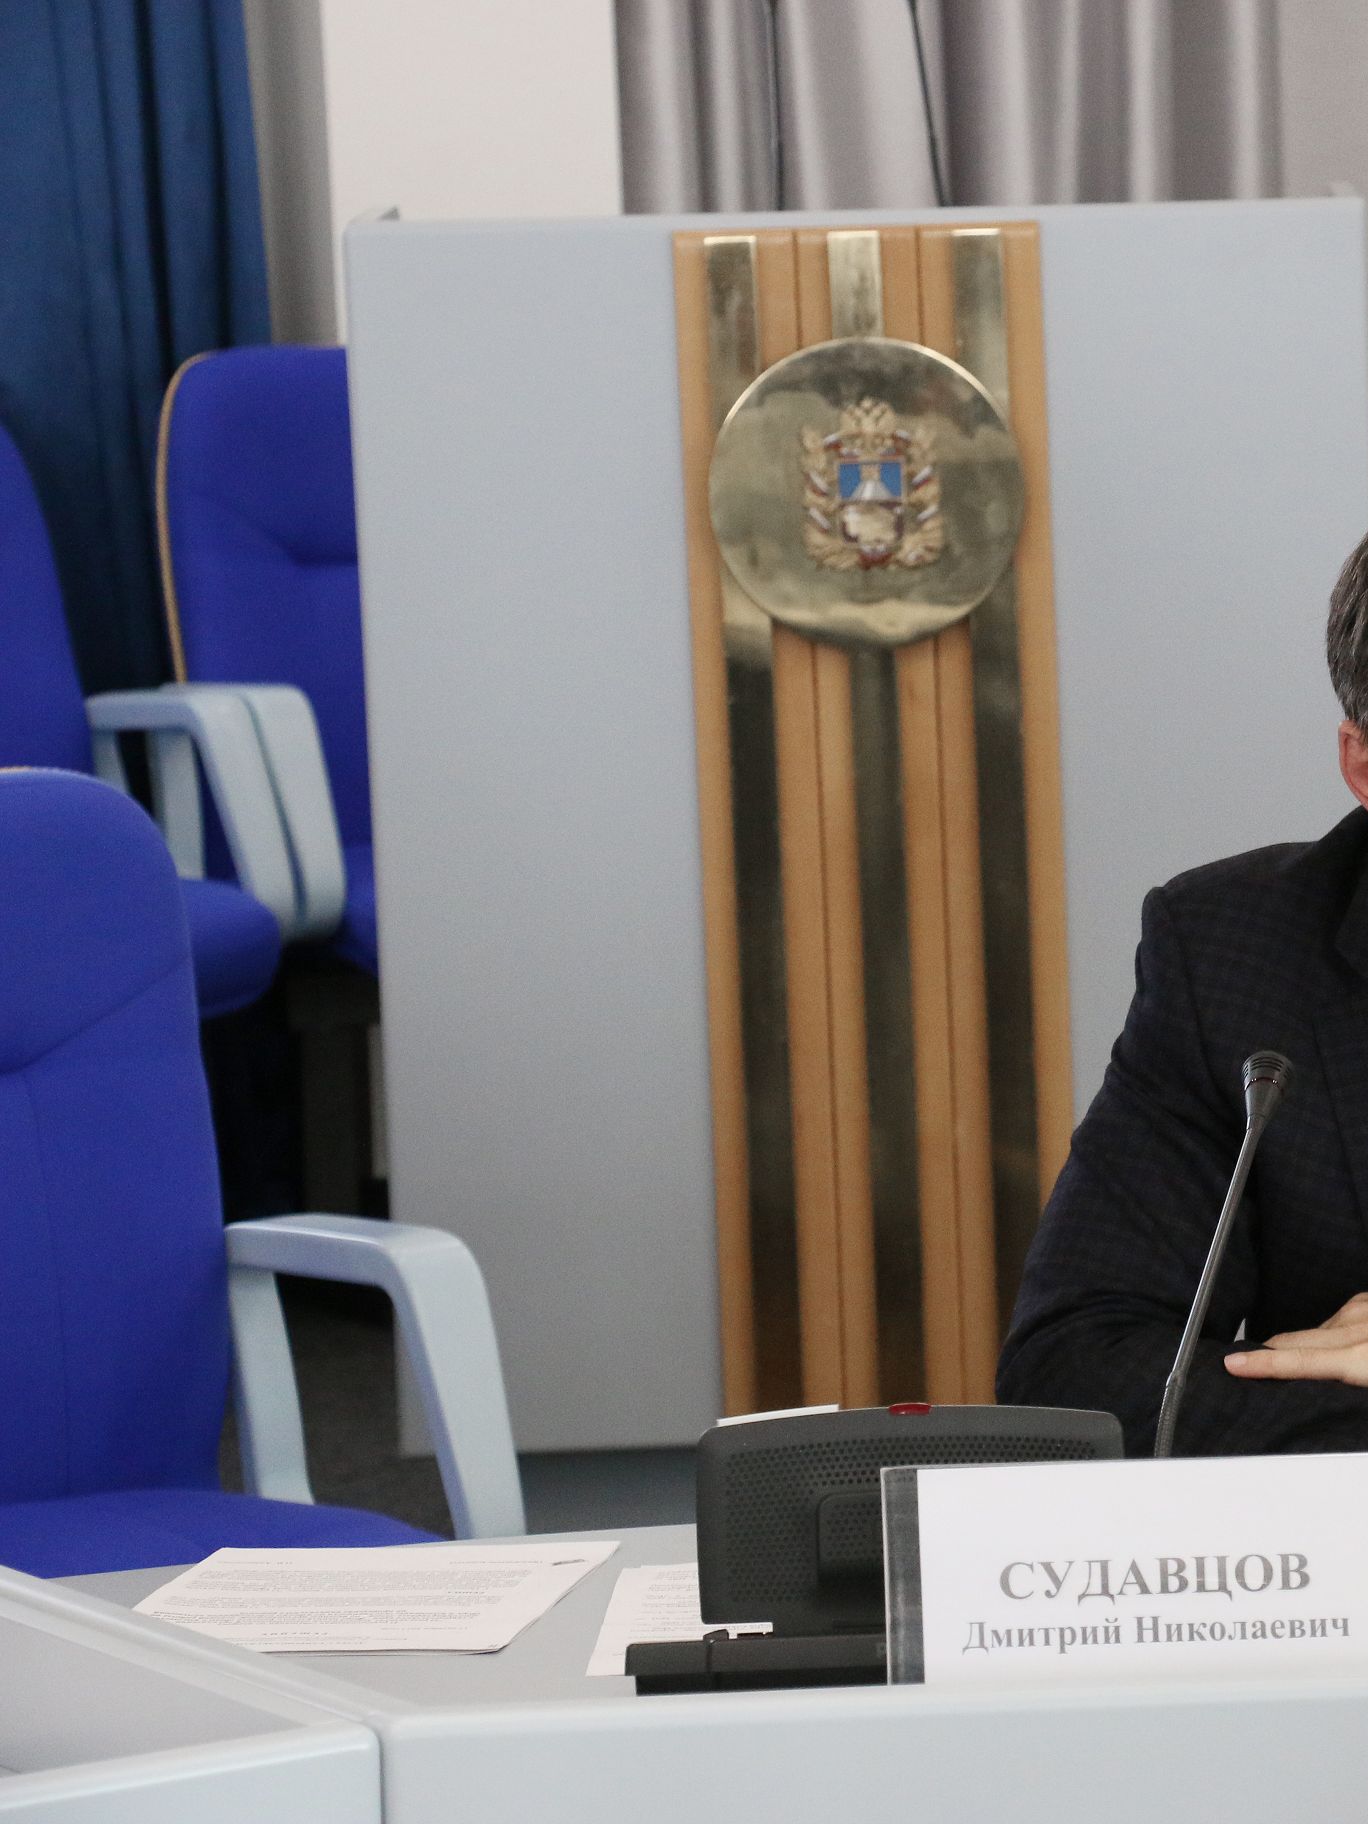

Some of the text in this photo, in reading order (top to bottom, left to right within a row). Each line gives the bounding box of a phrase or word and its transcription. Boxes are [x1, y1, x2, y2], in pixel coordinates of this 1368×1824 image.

[999, 1552, 1311, 1606] СУДАВЦОВ
[962, 1615, 1351, 1654] Дмитрий Николаевич
